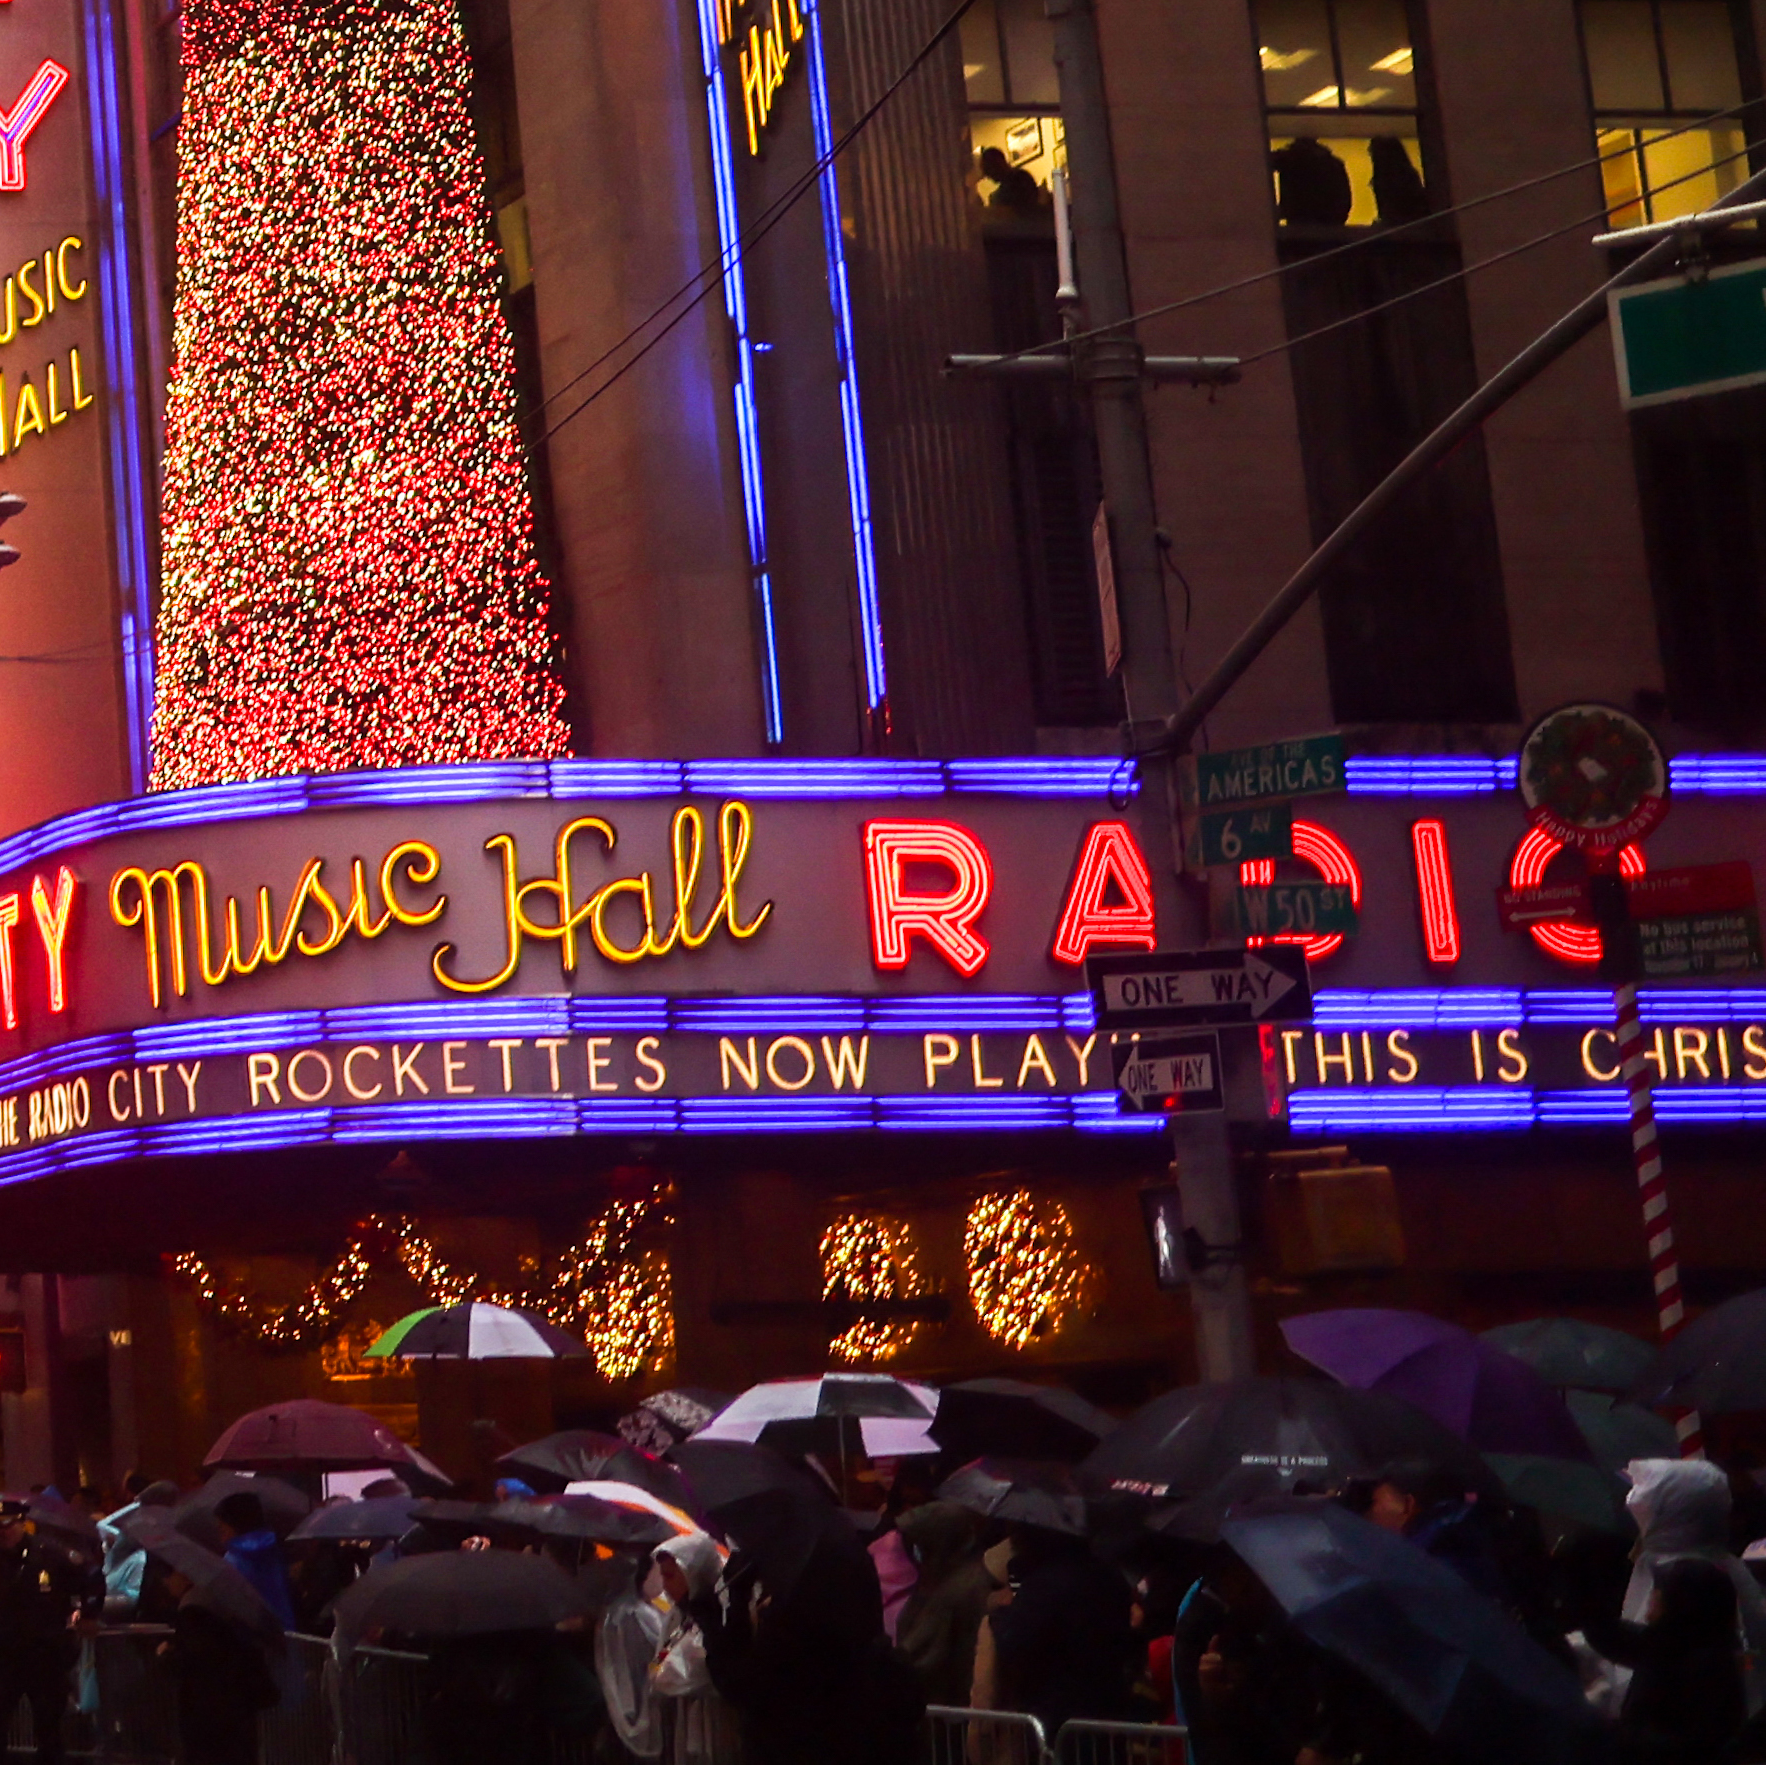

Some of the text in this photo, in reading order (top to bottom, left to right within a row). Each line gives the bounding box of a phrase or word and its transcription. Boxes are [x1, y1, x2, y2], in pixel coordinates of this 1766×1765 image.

[1207, 754, 1337, 802] AMERICAS
[1221, 812, 1271, 859] 6 AV
[1535, 800, 1659, 847] Happy Holidays
[432, 800, 773, 994] Hall
[1243, 886, 1346, 935] W 50 ST
[1120, 970, 1275, 1007] ONE WAY
[28, 1076, 90, 1143] RADIO
[107, 1060, 202, 1123] CITY
[247, 1035, 667, 1106] ROCKETTES
[719, 1035, 872, 1091] NOW
[1277, 1028, 1420, 1085] THIS
[1470, 1027, 1528, 1083] IS
[1128, 1058, 1204, 1094] ONE WAY
